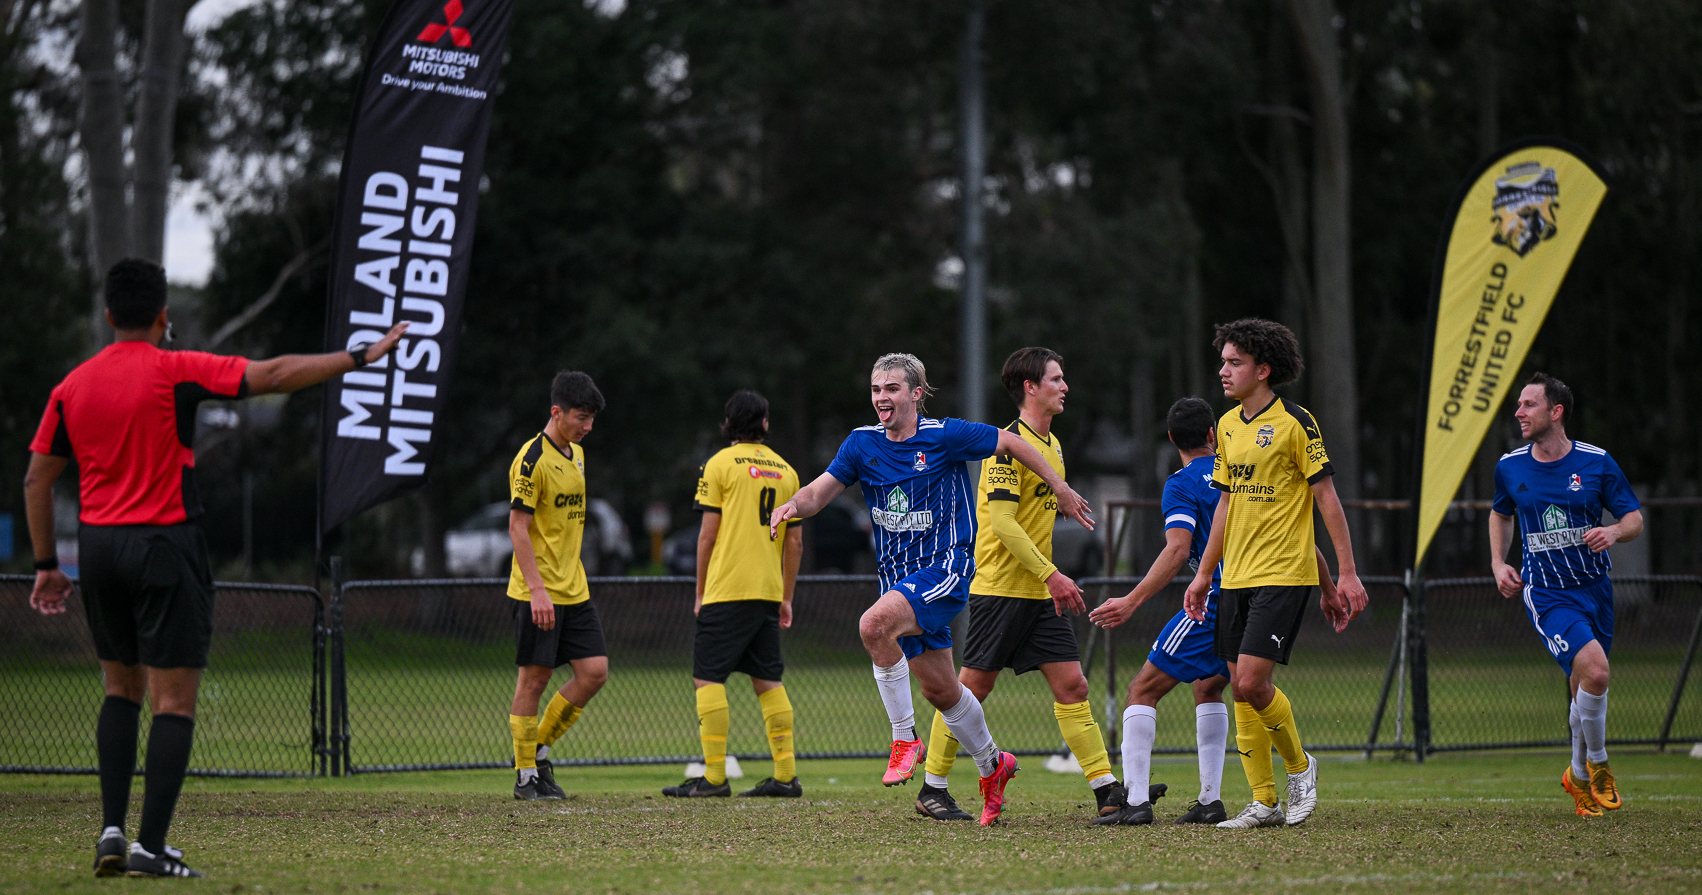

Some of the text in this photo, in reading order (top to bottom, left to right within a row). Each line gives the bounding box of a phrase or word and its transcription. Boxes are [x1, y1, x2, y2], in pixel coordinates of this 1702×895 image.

[402, 43, 480, 69] MITSUBISHI
[408, 60, 467, 80] MOTORS
[381, 73, 488, 100] Drive your Ambition
[384, 145, 465, 476] MITSUBISHI
[1438, 262, 1508, 432] FORRESTFIELD
[1472, 292, 1525, 413] UNITED FC
[916, 512, 931, 525] LTD
[1536, 532, 1560, 546] WEST
[1561, 529, 1577, 543] PTY
[1553, 633, 1570, 652] 8
